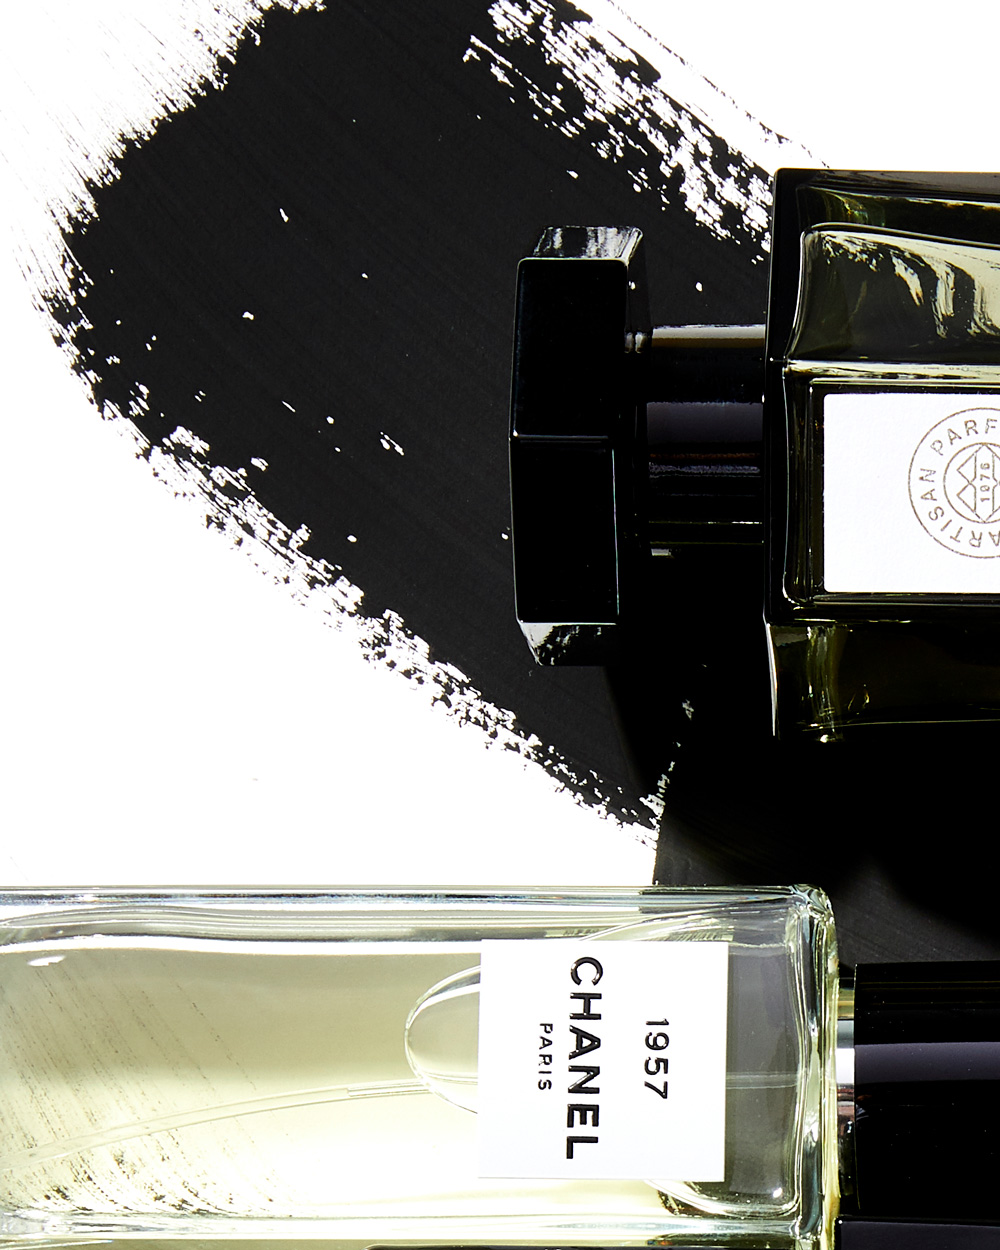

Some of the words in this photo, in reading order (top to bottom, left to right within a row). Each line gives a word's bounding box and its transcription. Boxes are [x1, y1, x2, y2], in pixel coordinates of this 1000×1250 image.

[979, 462, 991, 503] 1976
[537, 1023, 554, 1091] PARIS
[566, 956, 604, 1160] CHANEL
[644, 1018, 670, 1100] 1957
